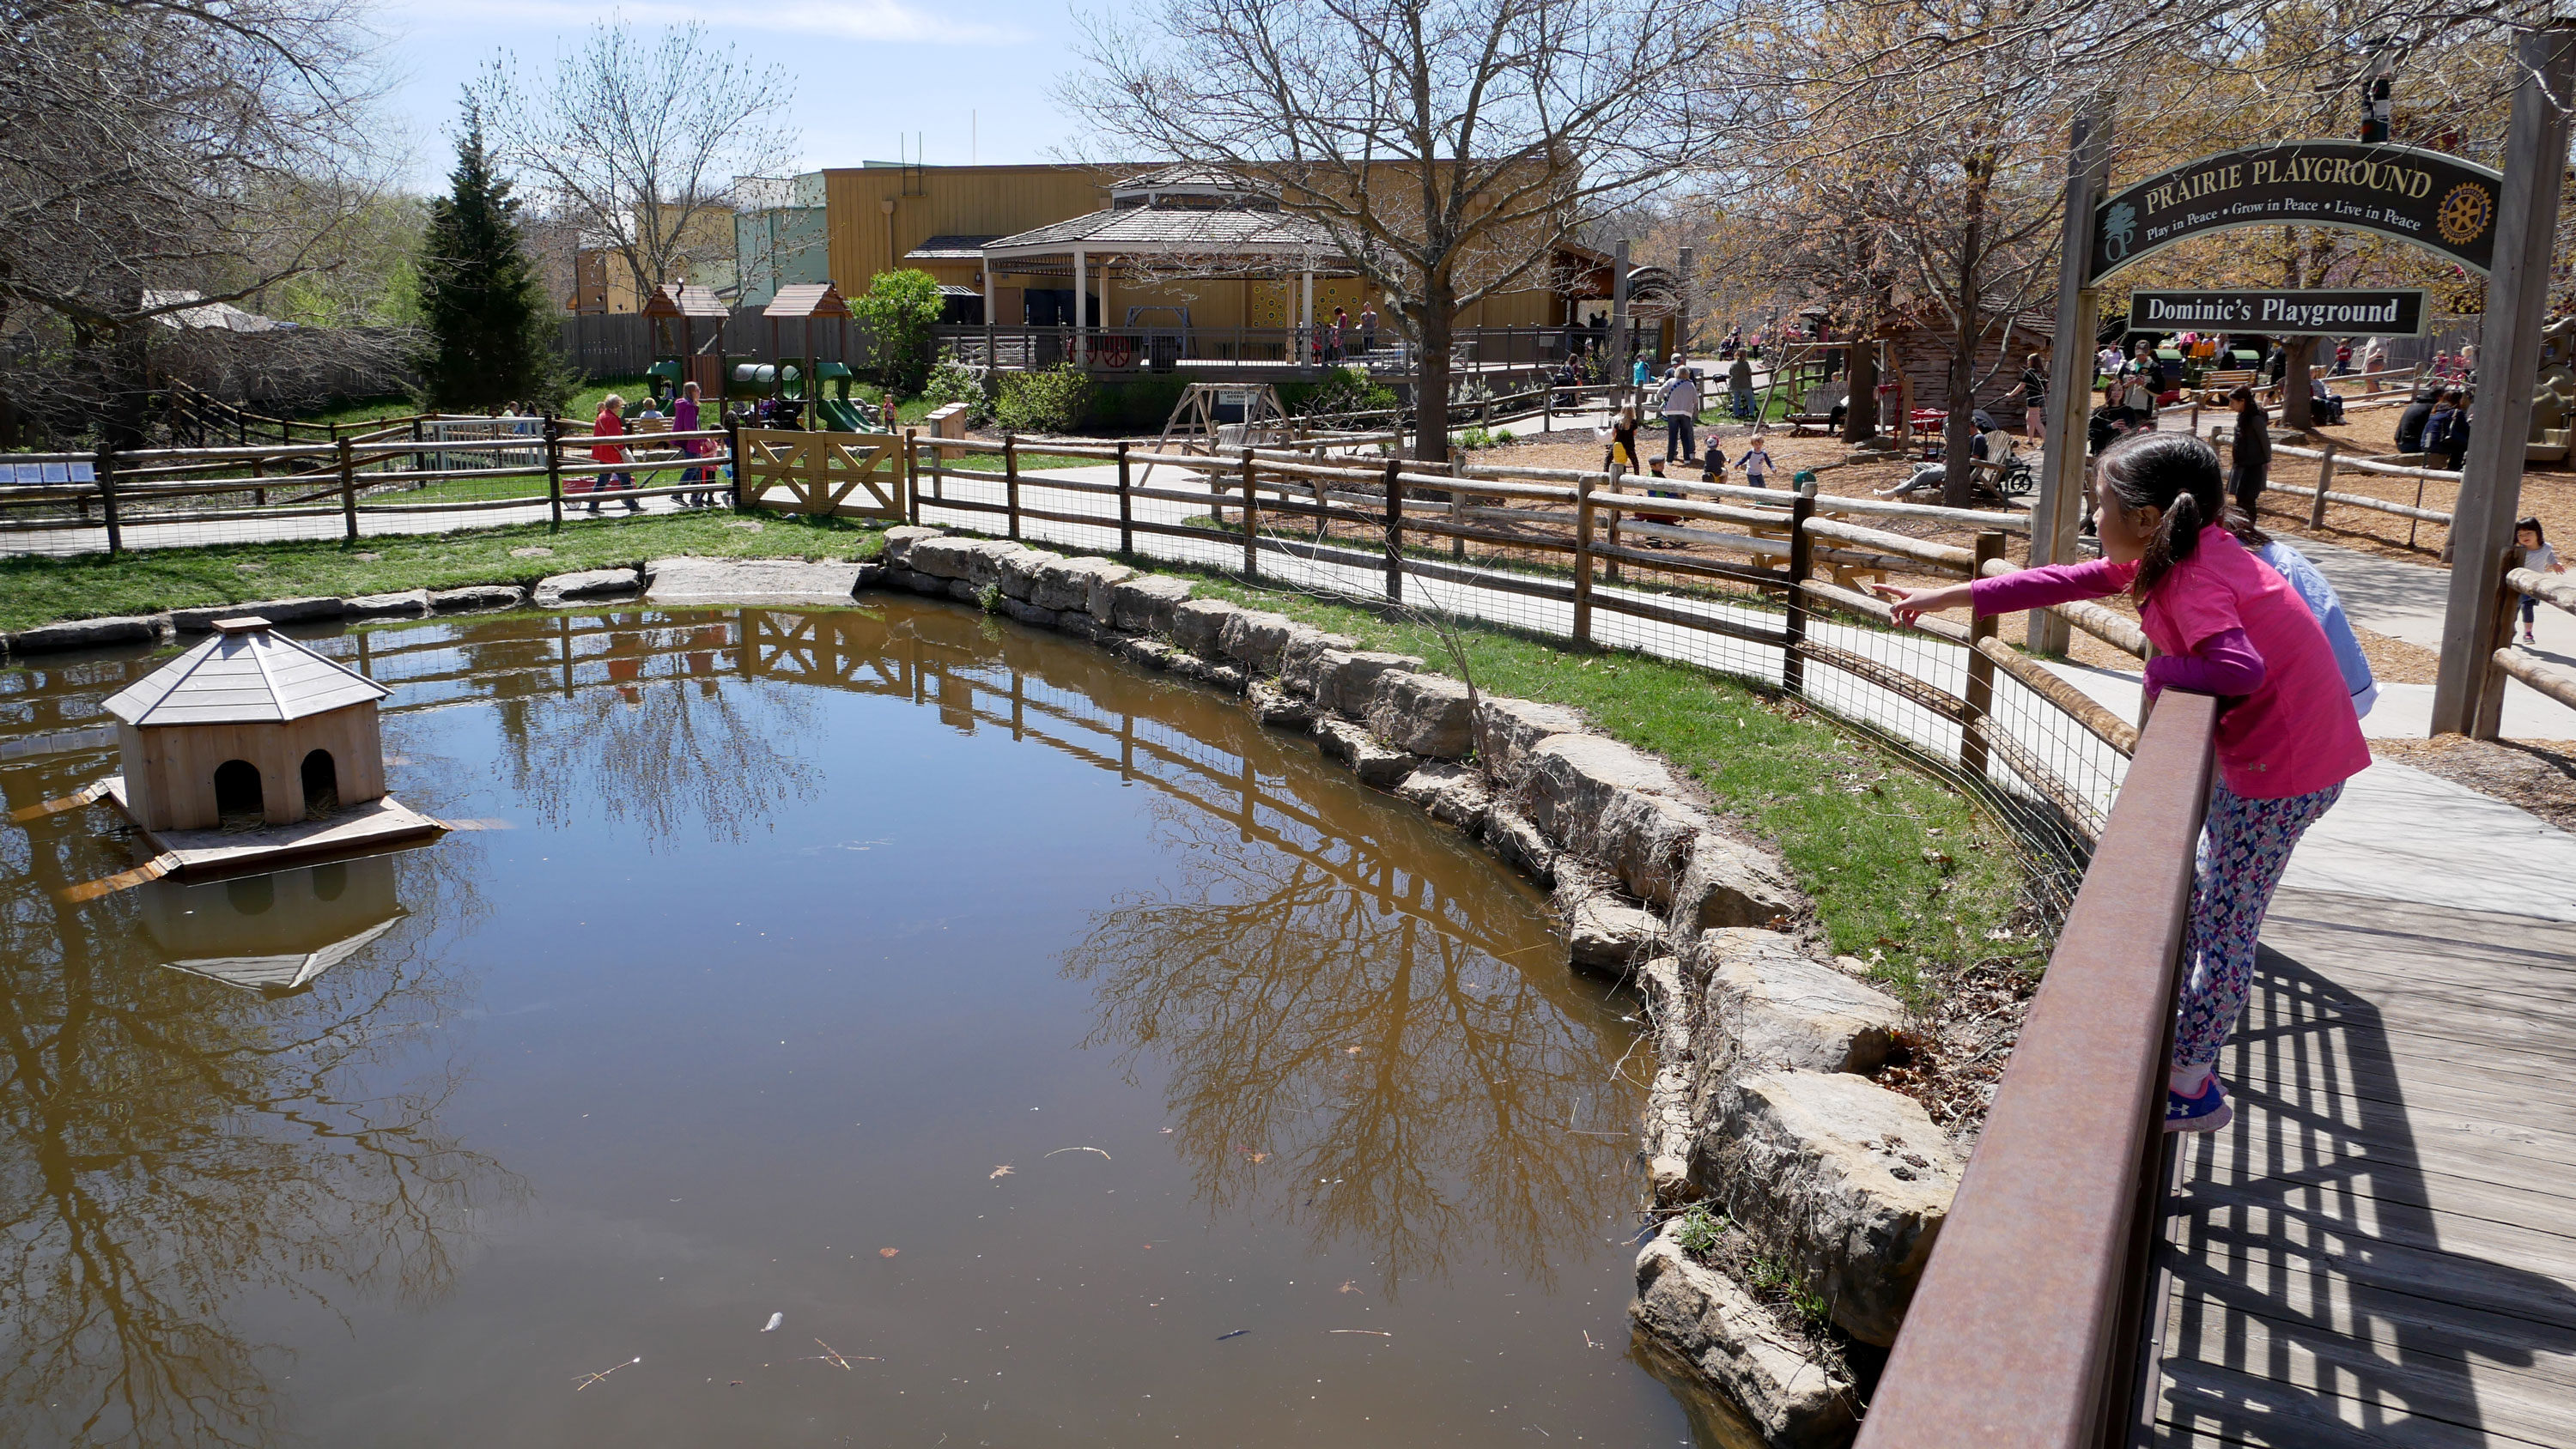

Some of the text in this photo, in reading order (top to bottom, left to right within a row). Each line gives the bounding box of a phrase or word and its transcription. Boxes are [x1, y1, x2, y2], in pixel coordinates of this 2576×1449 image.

[2144, 157, 2432, 215] PRAIRIE PLAYGROUND
[2463, 189, 2483, 200] ROTARY
[2146, 197, 2421, 241] Play in Peace Grow in Peace Live in Peace
[2147, 298, 2398, 326] Dominic's Playground
